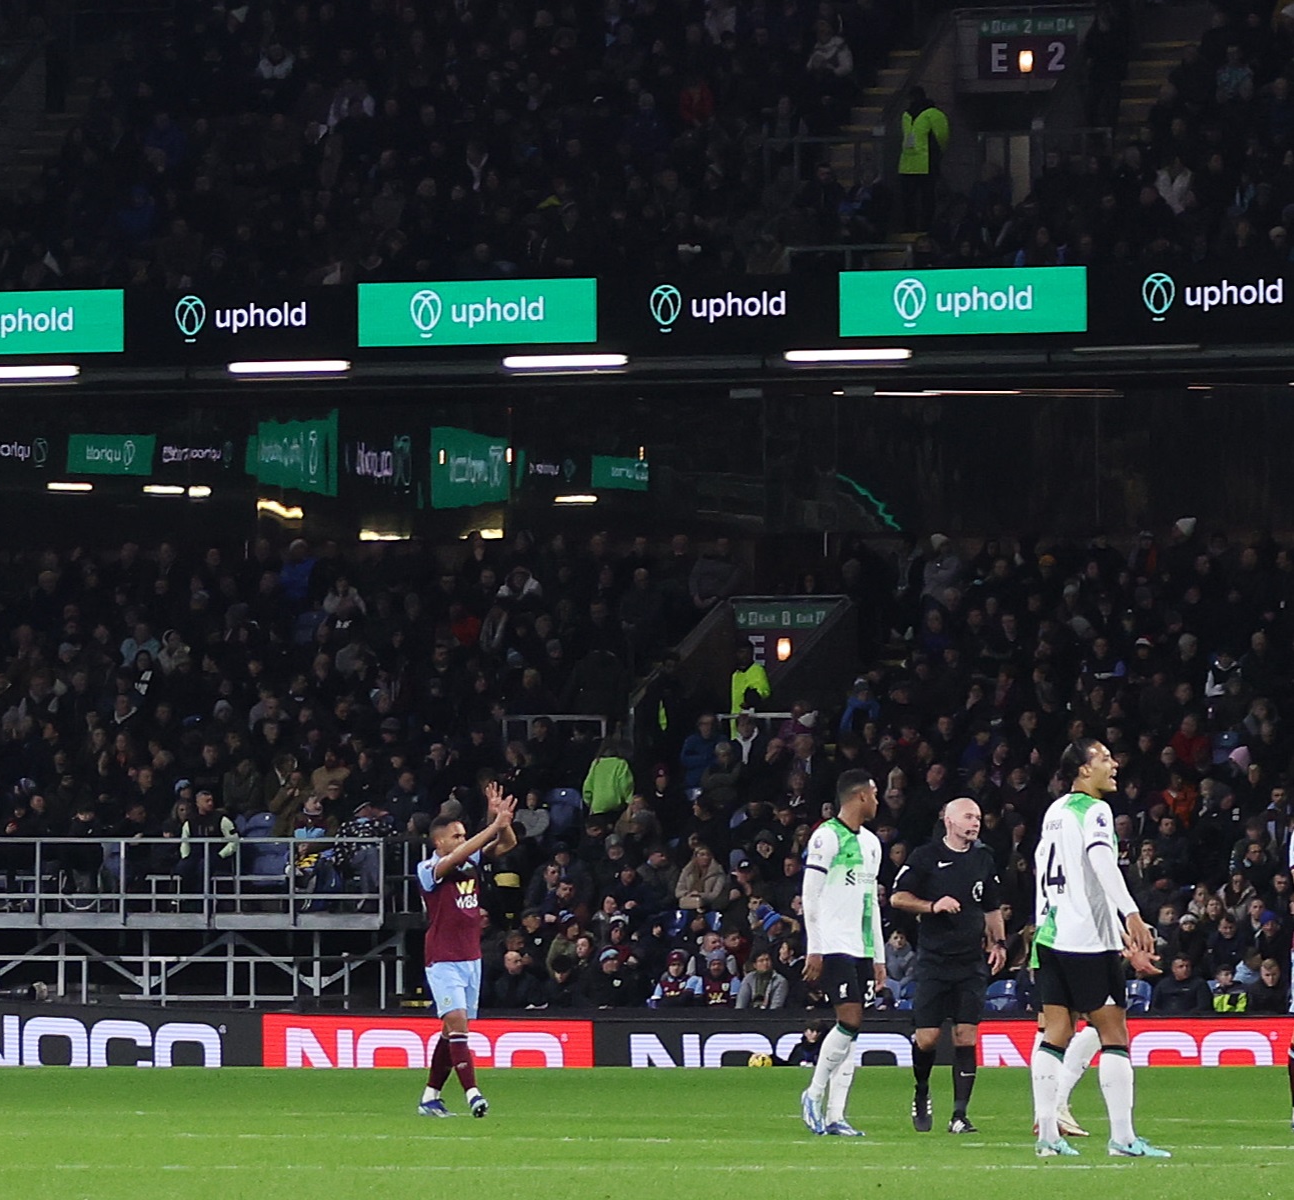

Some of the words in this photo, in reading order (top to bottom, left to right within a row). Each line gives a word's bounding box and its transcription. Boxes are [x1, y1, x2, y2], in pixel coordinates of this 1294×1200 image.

[990, 42, 1009, 73] E
[1046, 41, 1066, 72] 2
[215, 301, 306, 333] uphold
[451, 295, 544, 328] uphold
[691, 290, 786, 323] uphold
[936, 285, 1033, 317] uphold
[1185, 277, 1283, 312] uphold
